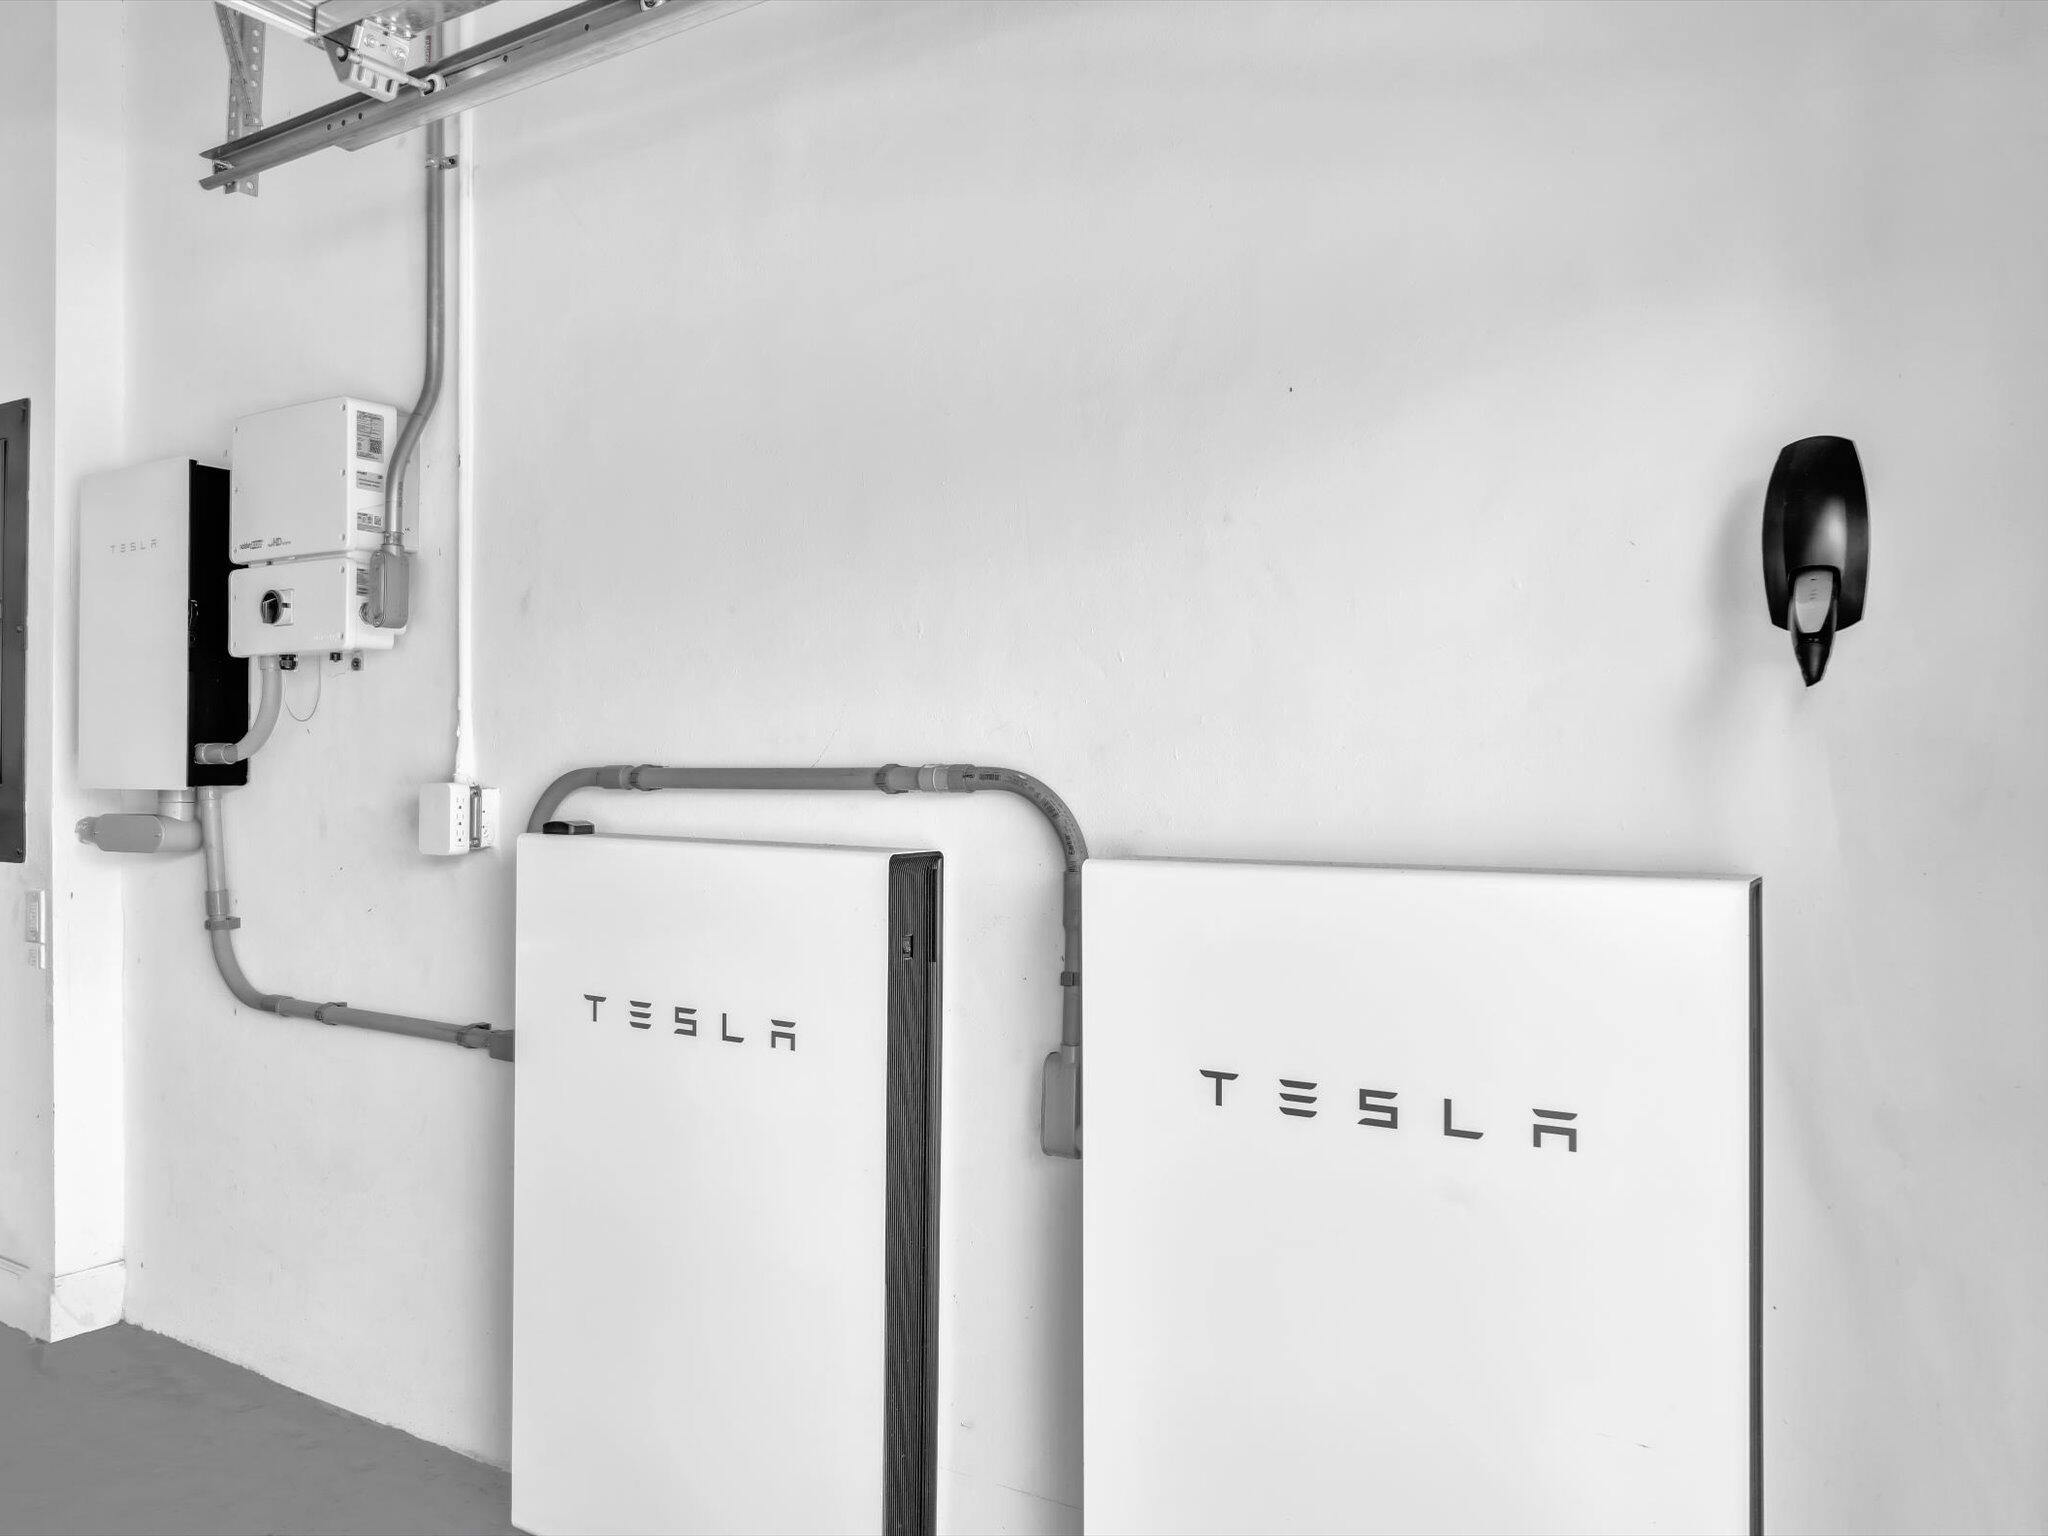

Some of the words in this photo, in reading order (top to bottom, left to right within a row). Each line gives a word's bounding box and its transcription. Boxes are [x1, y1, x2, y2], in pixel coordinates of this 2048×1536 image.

[109, 537, 158, 554] TESLA
[583, 993, 797, 1052] TESLA
[1199, 1069, 1578, 1153] TESLA
